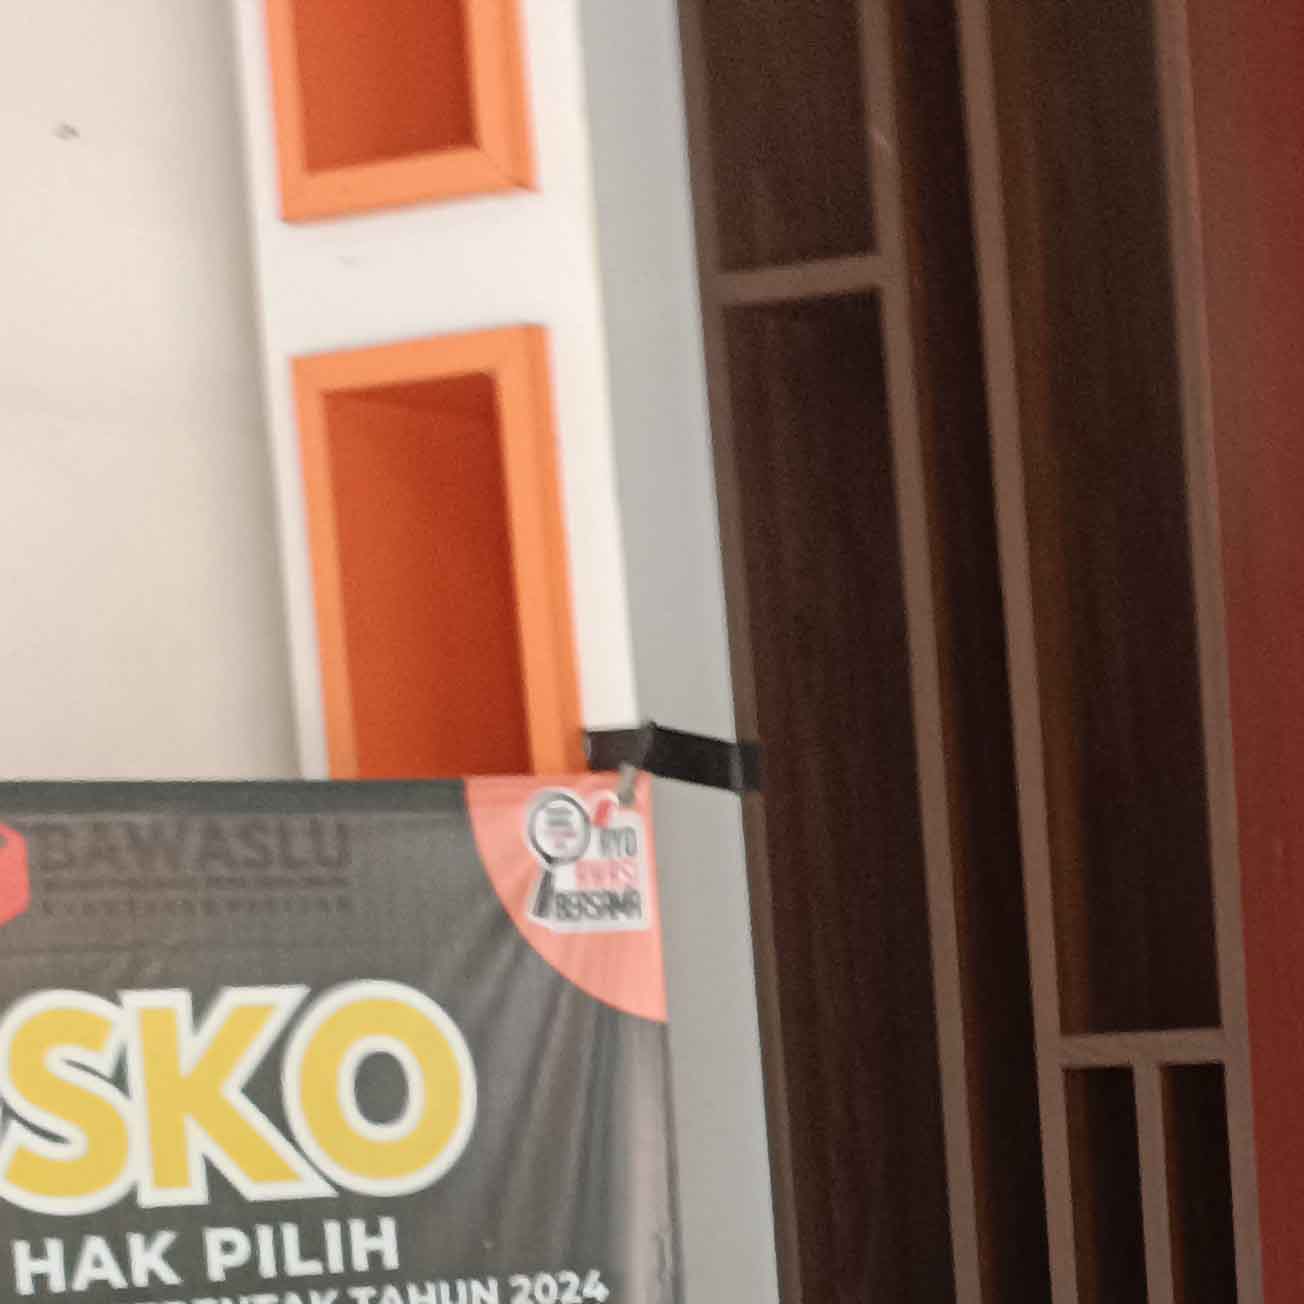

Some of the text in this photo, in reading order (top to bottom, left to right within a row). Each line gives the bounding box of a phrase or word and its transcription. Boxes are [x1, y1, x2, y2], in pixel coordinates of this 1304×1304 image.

[0, 979, 478, 1216] SKO
[13, 1216, 400, 1295] HAK PILIH
